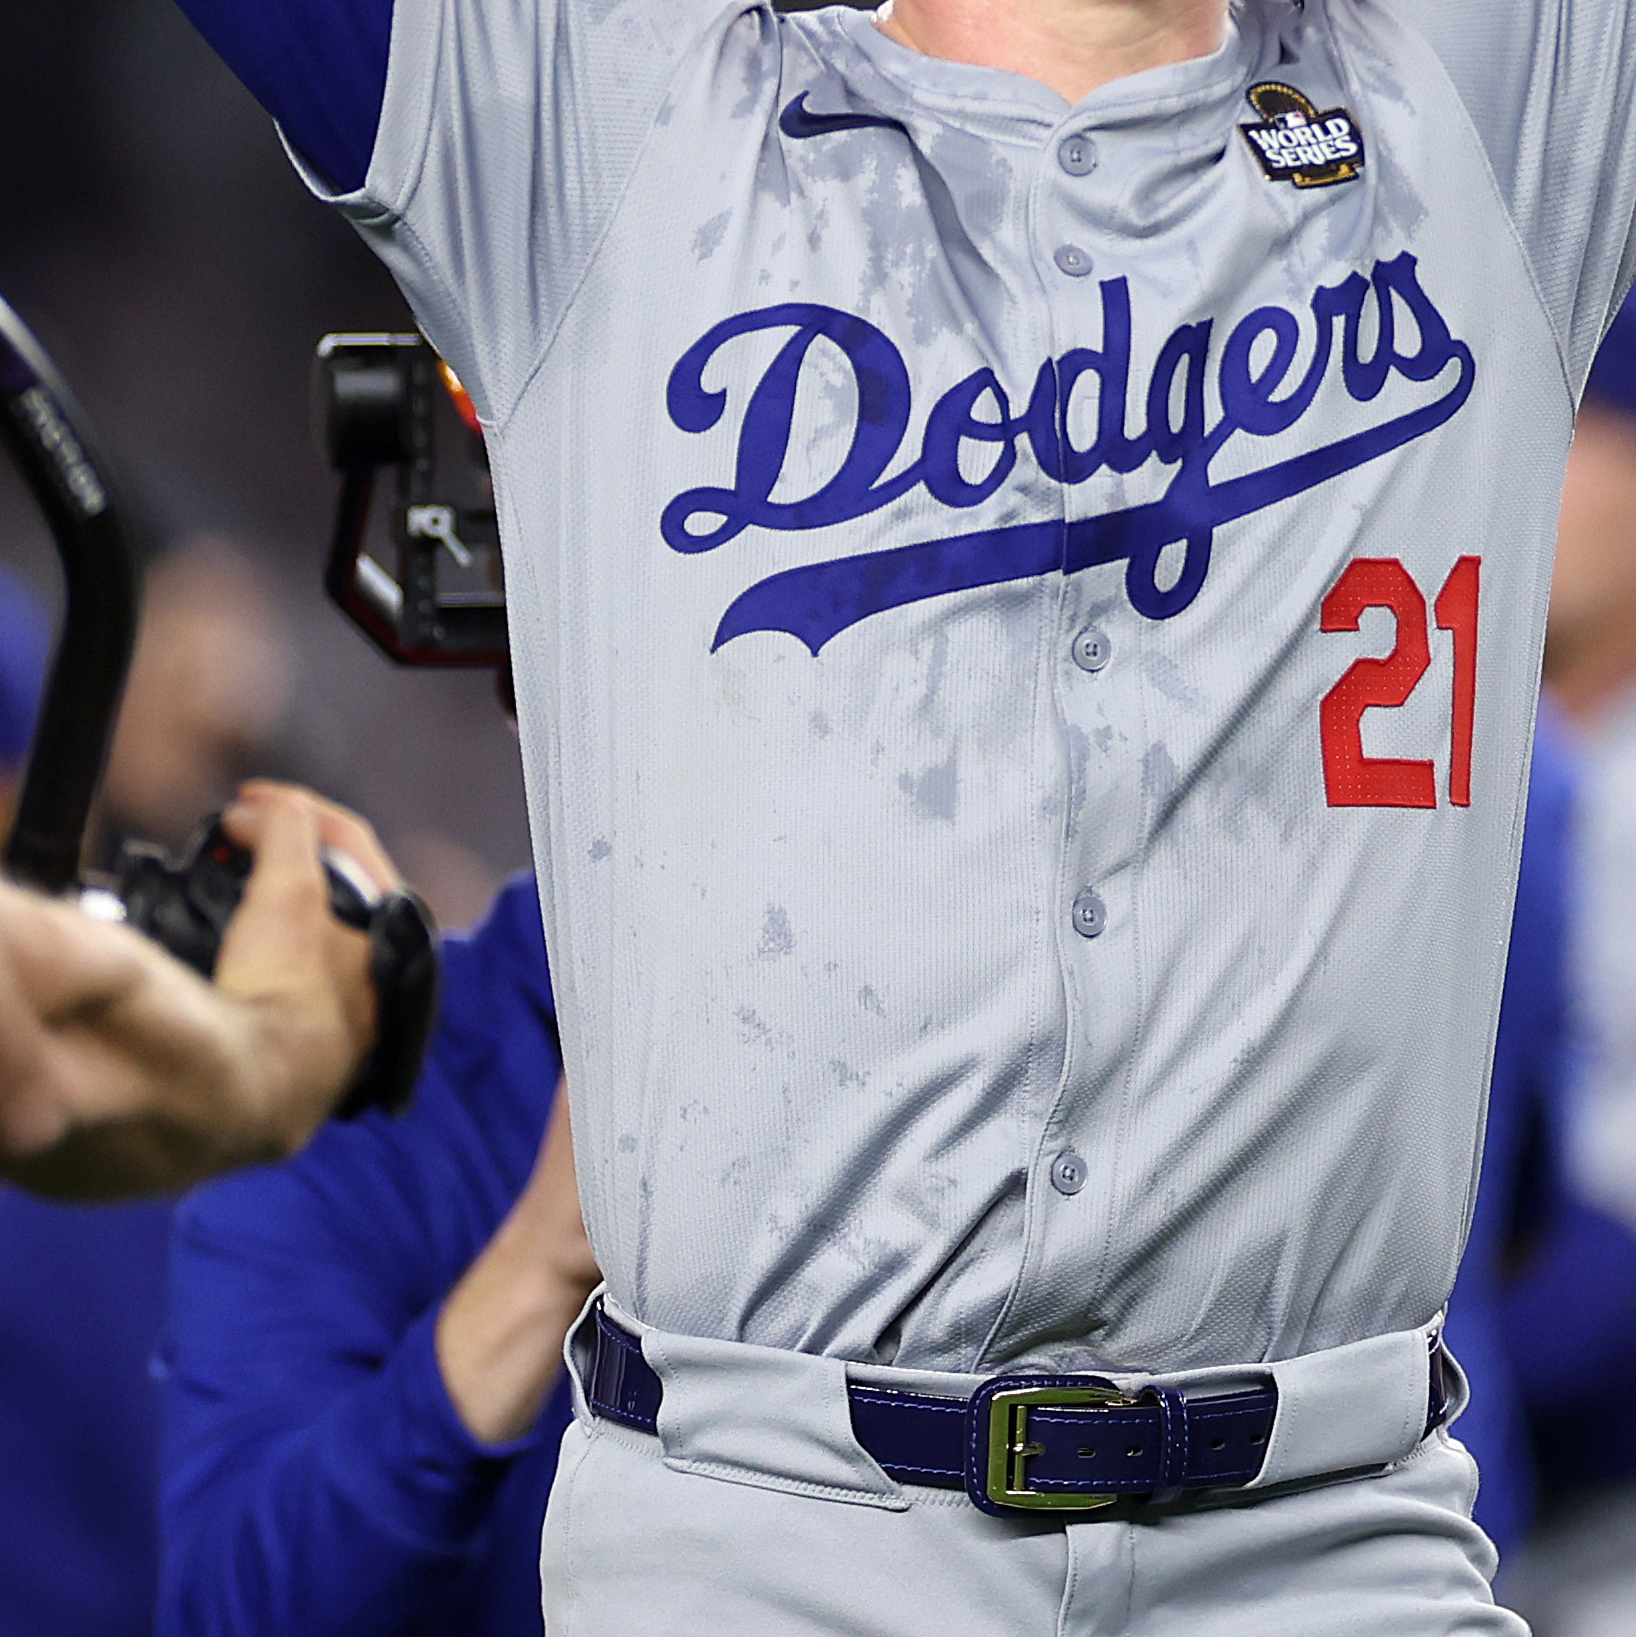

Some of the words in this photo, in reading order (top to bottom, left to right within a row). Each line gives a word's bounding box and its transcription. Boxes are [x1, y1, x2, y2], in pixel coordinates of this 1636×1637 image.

[1247, 117, 1351, 152] WORLD
[1265, 135, 1359, 168] SERIES
[660, 250, 1476, 657] Dodgers
[1319, 555, 1482, 809] 21
